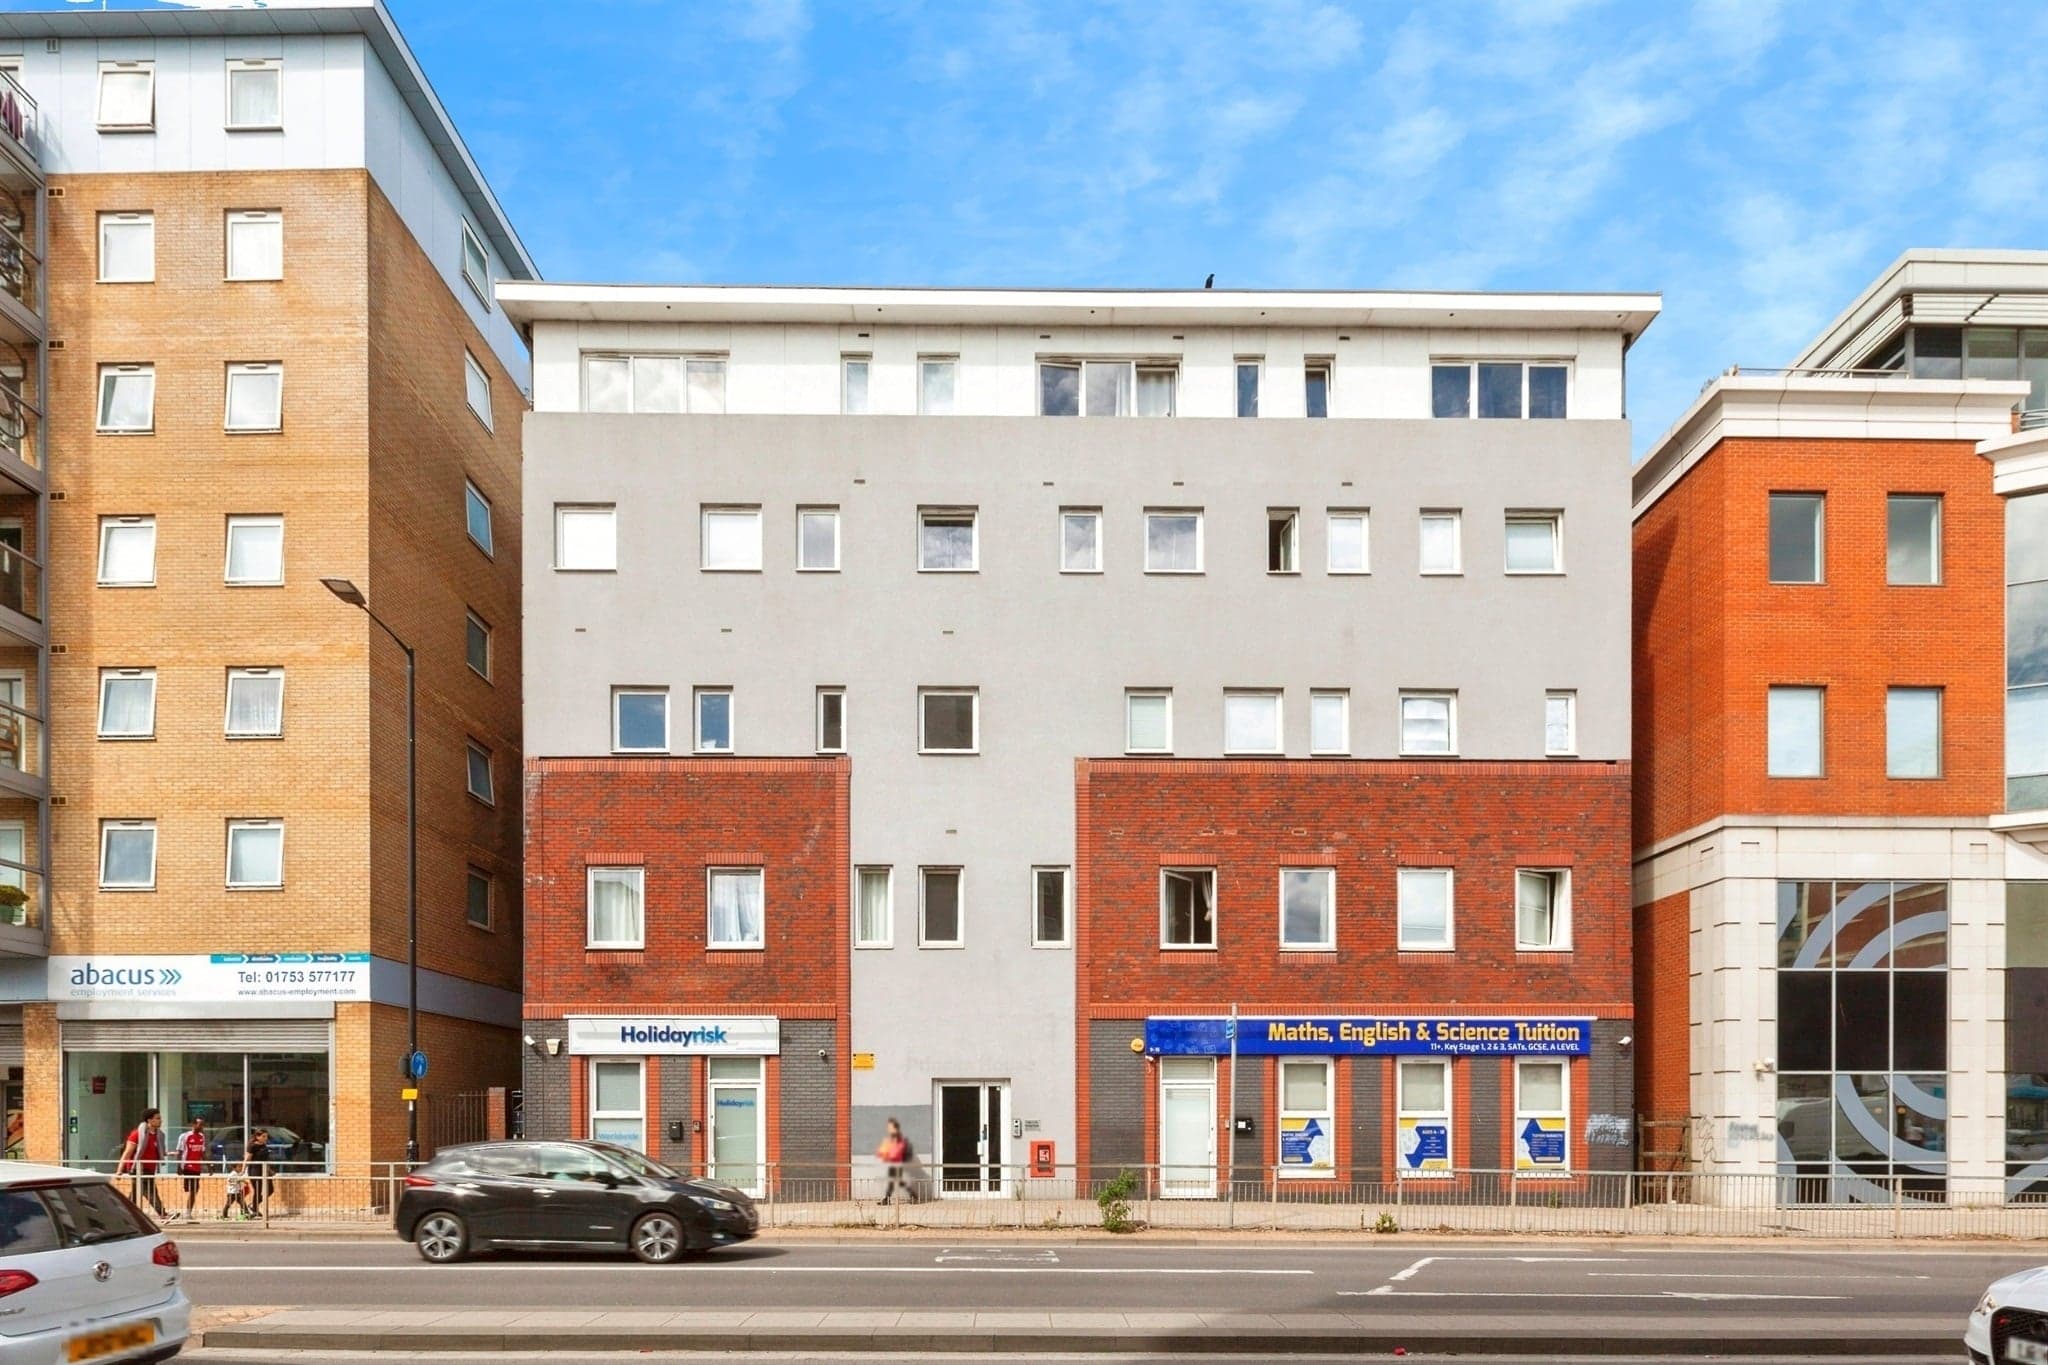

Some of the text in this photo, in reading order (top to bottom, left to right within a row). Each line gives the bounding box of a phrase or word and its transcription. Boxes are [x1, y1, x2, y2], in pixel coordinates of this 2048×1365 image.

[71, 963, 154, 985] abacus
[238, 971, 356, 983] Tel: 01753 577177
[70, 988, 177, 998] employment services
[238, 988, 356, 997] www.abacus-employment.com
[621, 1026, 727, 1047] Holidayrisk
[1268, 1021, 1580, 1047] Maths, English & Science Tuition
[1444, 1043, 1458, 1054] Key
[1459, 1043, 1479, 1052] Stage
[1556, 1043, 1579, 1051] LEVEL
